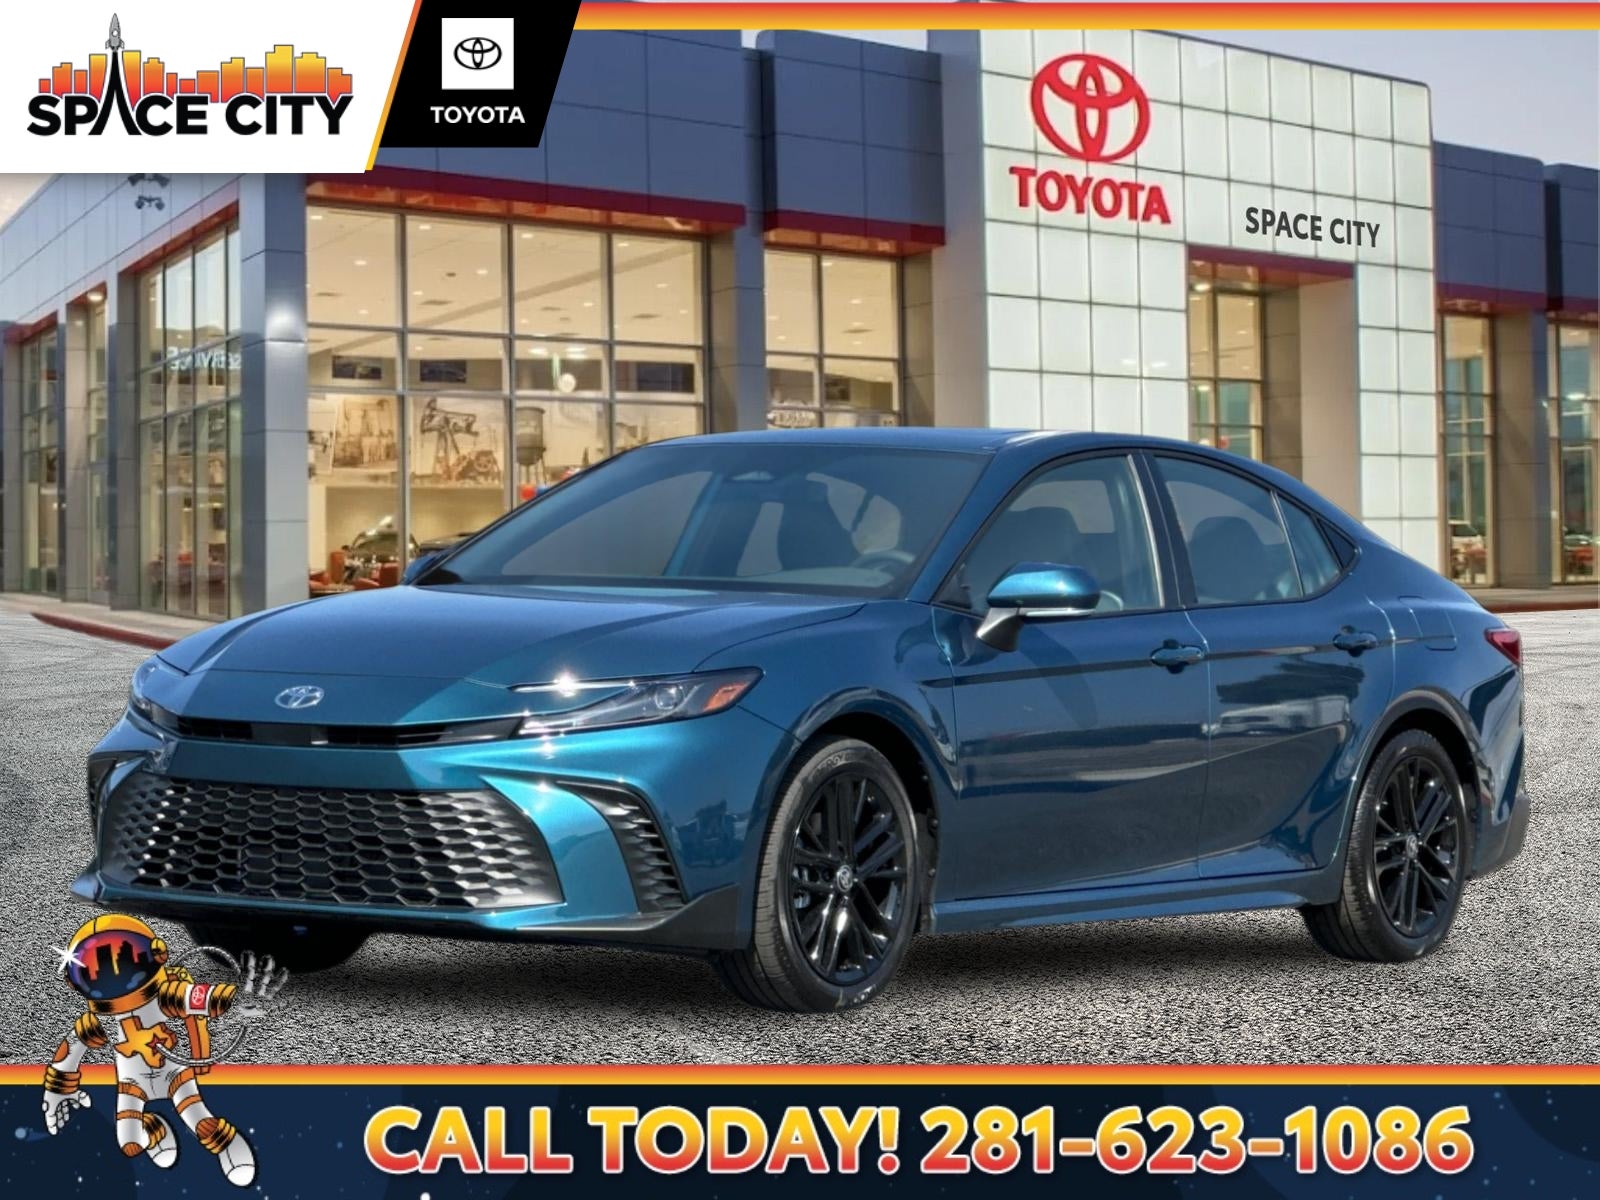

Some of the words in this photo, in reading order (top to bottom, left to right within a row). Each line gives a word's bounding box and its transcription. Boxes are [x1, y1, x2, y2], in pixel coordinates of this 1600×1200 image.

[1009, 166, 1171, 224] TOYOTA
[1245, 206, 1322, 241] SPACE
[1329, 218, 1380, 248] CITY
